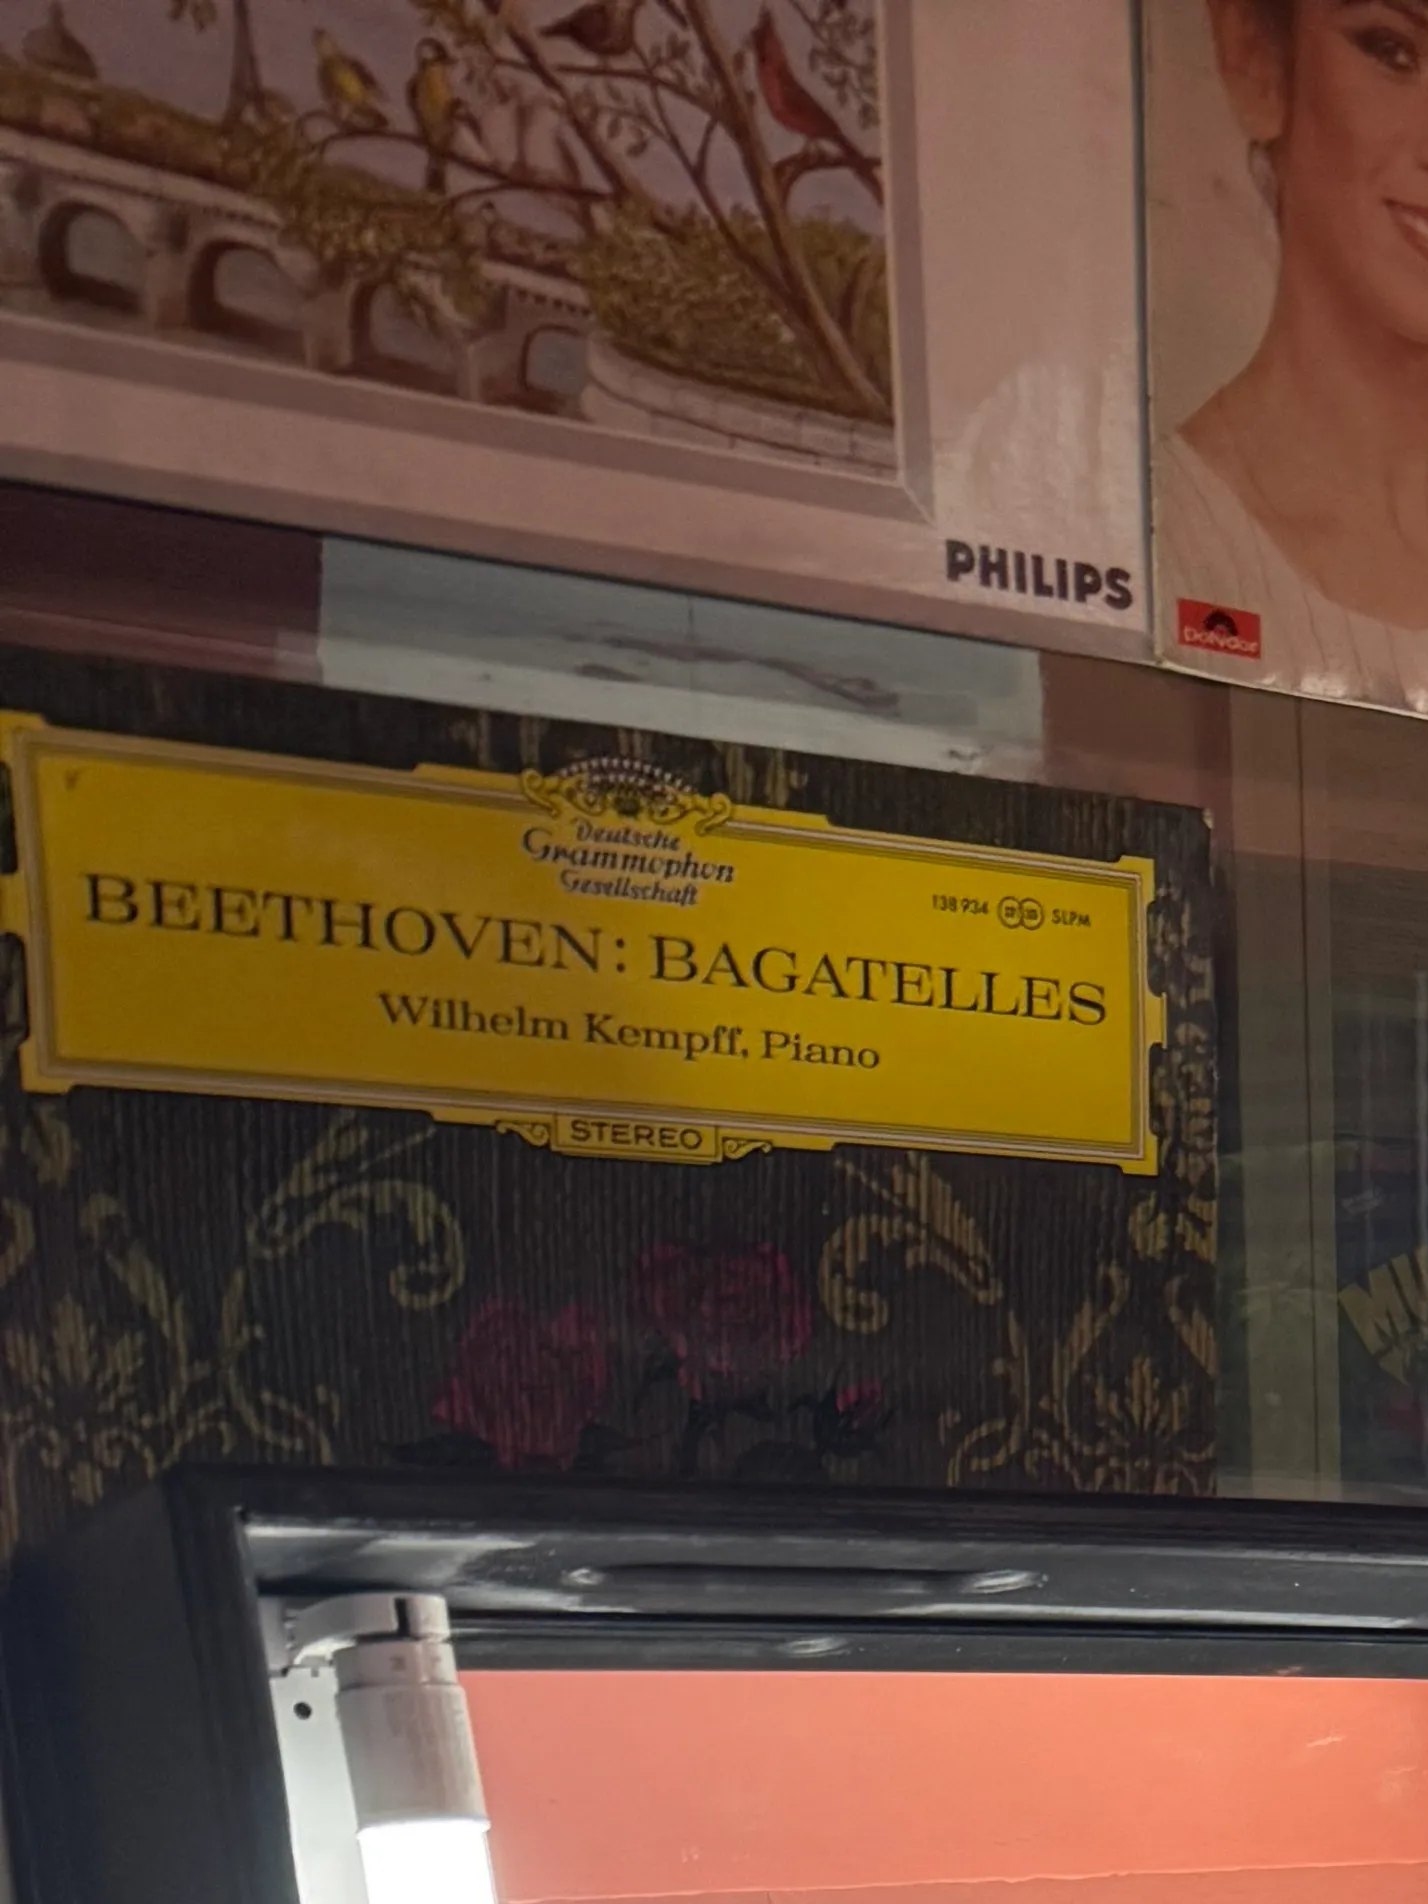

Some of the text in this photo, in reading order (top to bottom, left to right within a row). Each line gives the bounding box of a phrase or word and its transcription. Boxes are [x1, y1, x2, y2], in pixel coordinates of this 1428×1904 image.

[946, 539, 1132, 610] PHILIPS
[522, 827, 734, 884] Grammophon
[575, 816, 681, 852] Deutsche
[561, 869, 698, 906] Gesellschaft
[83, 872, 1106, 1026] BEETHOVEN: BAGATELLES
[378, 991, 880, 1070] Wilhelm Kempff, Piano
[569, 1117, 703, 1152] STEREO
